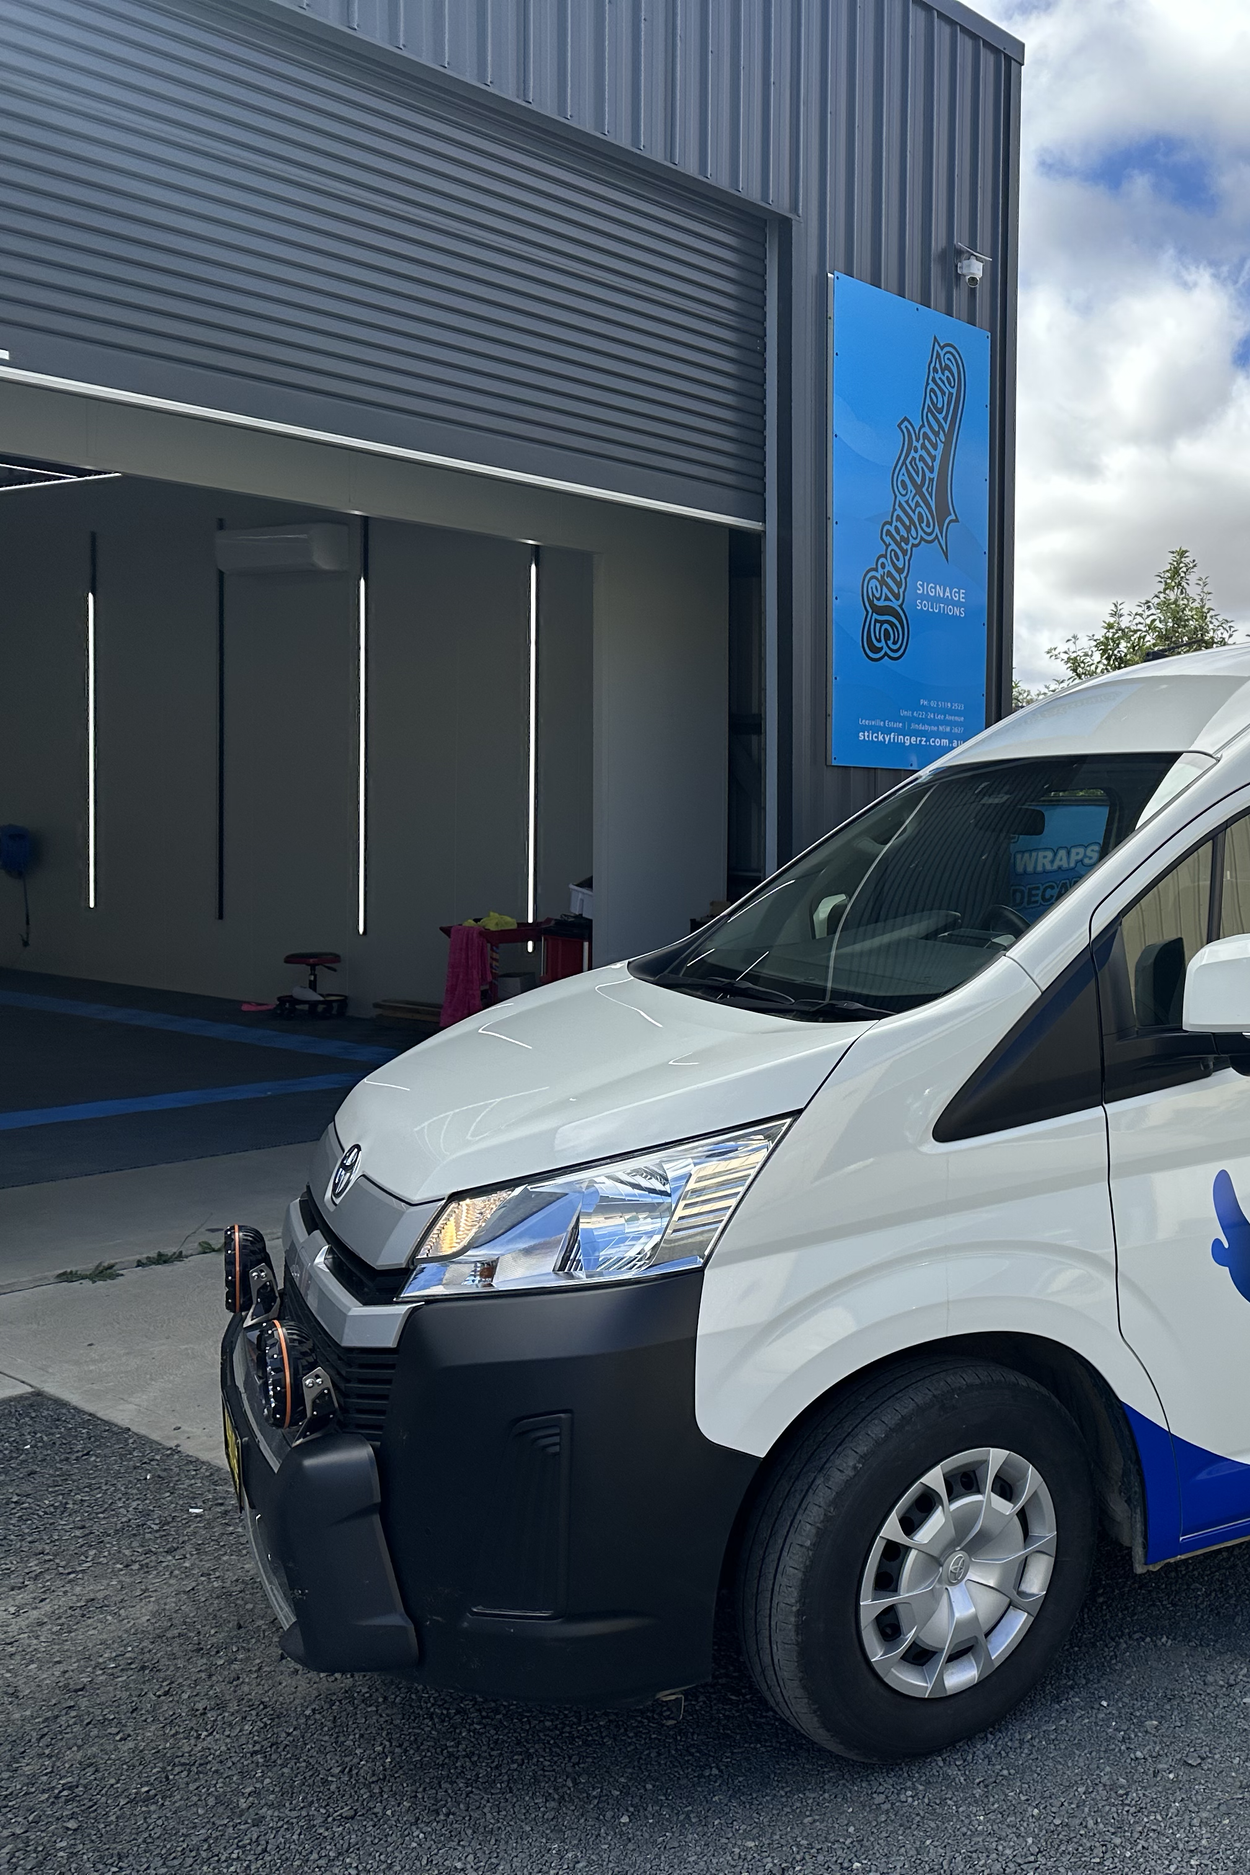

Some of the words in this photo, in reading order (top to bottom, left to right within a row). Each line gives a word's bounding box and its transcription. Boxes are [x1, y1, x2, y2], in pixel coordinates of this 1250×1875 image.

[916, 580, 966, 602] SIGNAGE
[916, 599, 965, 617] SOLUTIONS
[938, 701, 951, 709] 5119
[952, 702, 964, 710] 2523
[900, 709, 912, 717] Unit
[934, 712, 944, 720] Lee
[945, 713, 964, 722] Avenue
[859, 718, 884, 727] Leesville
[885, 720, 903, 728] Estate
[910, 722, 938, 732] Jindabyne
[1015, 843, 1100, 874] WRAPS
